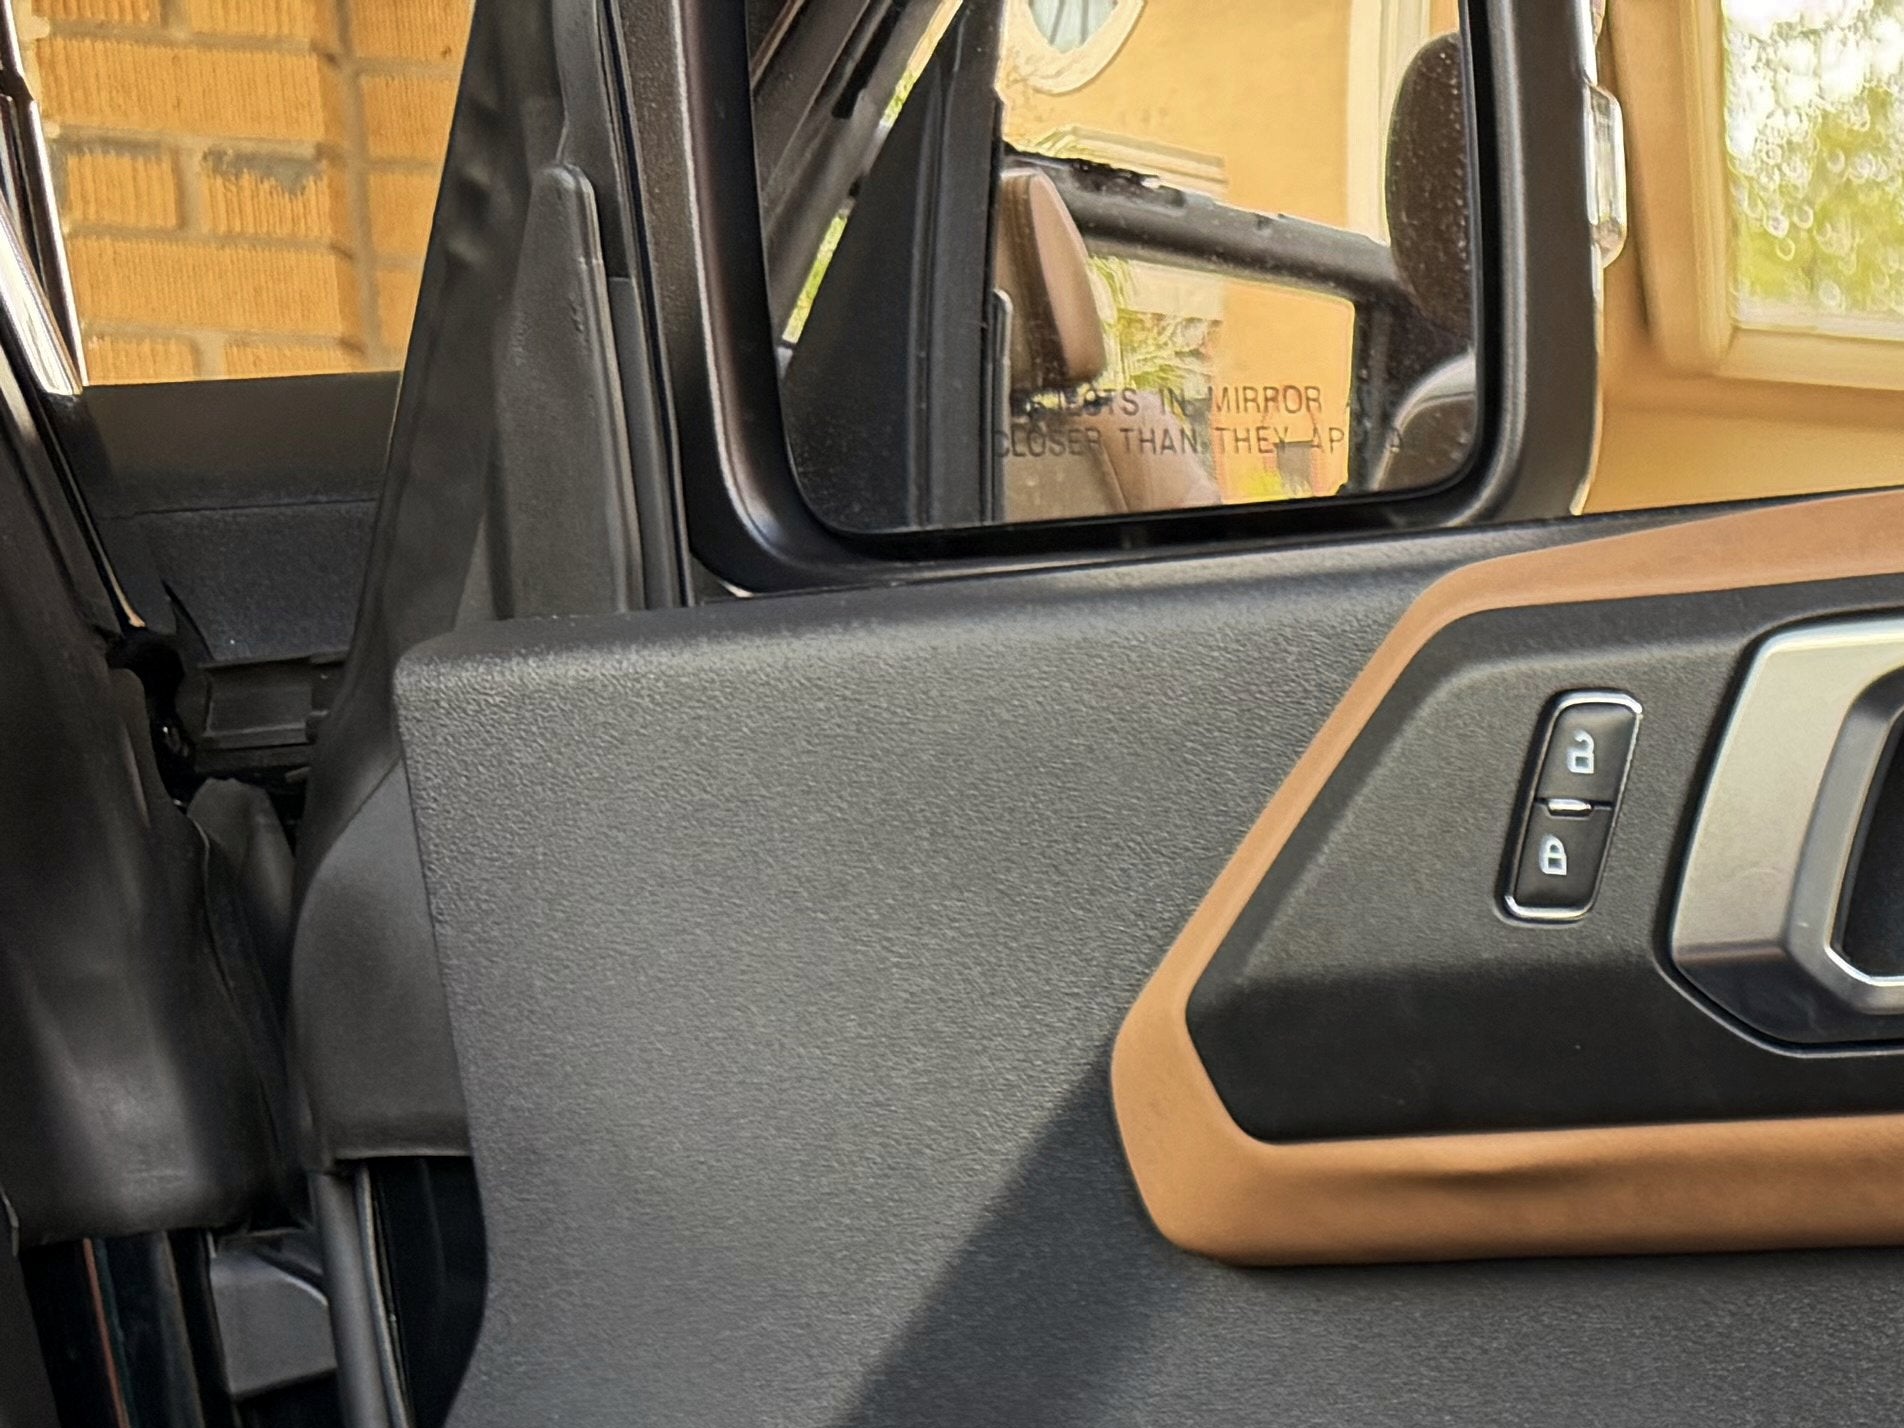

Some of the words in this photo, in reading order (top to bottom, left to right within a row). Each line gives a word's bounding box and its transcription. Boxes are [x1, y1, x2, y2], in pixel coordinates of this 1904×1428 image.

[1207, 385, 1322, 414] MIRROR
[995, 427, 1100, 457] CLOSER
[1119, 427, 1199, 454] THAN
[1213, 426, 1289, 454] THEY
